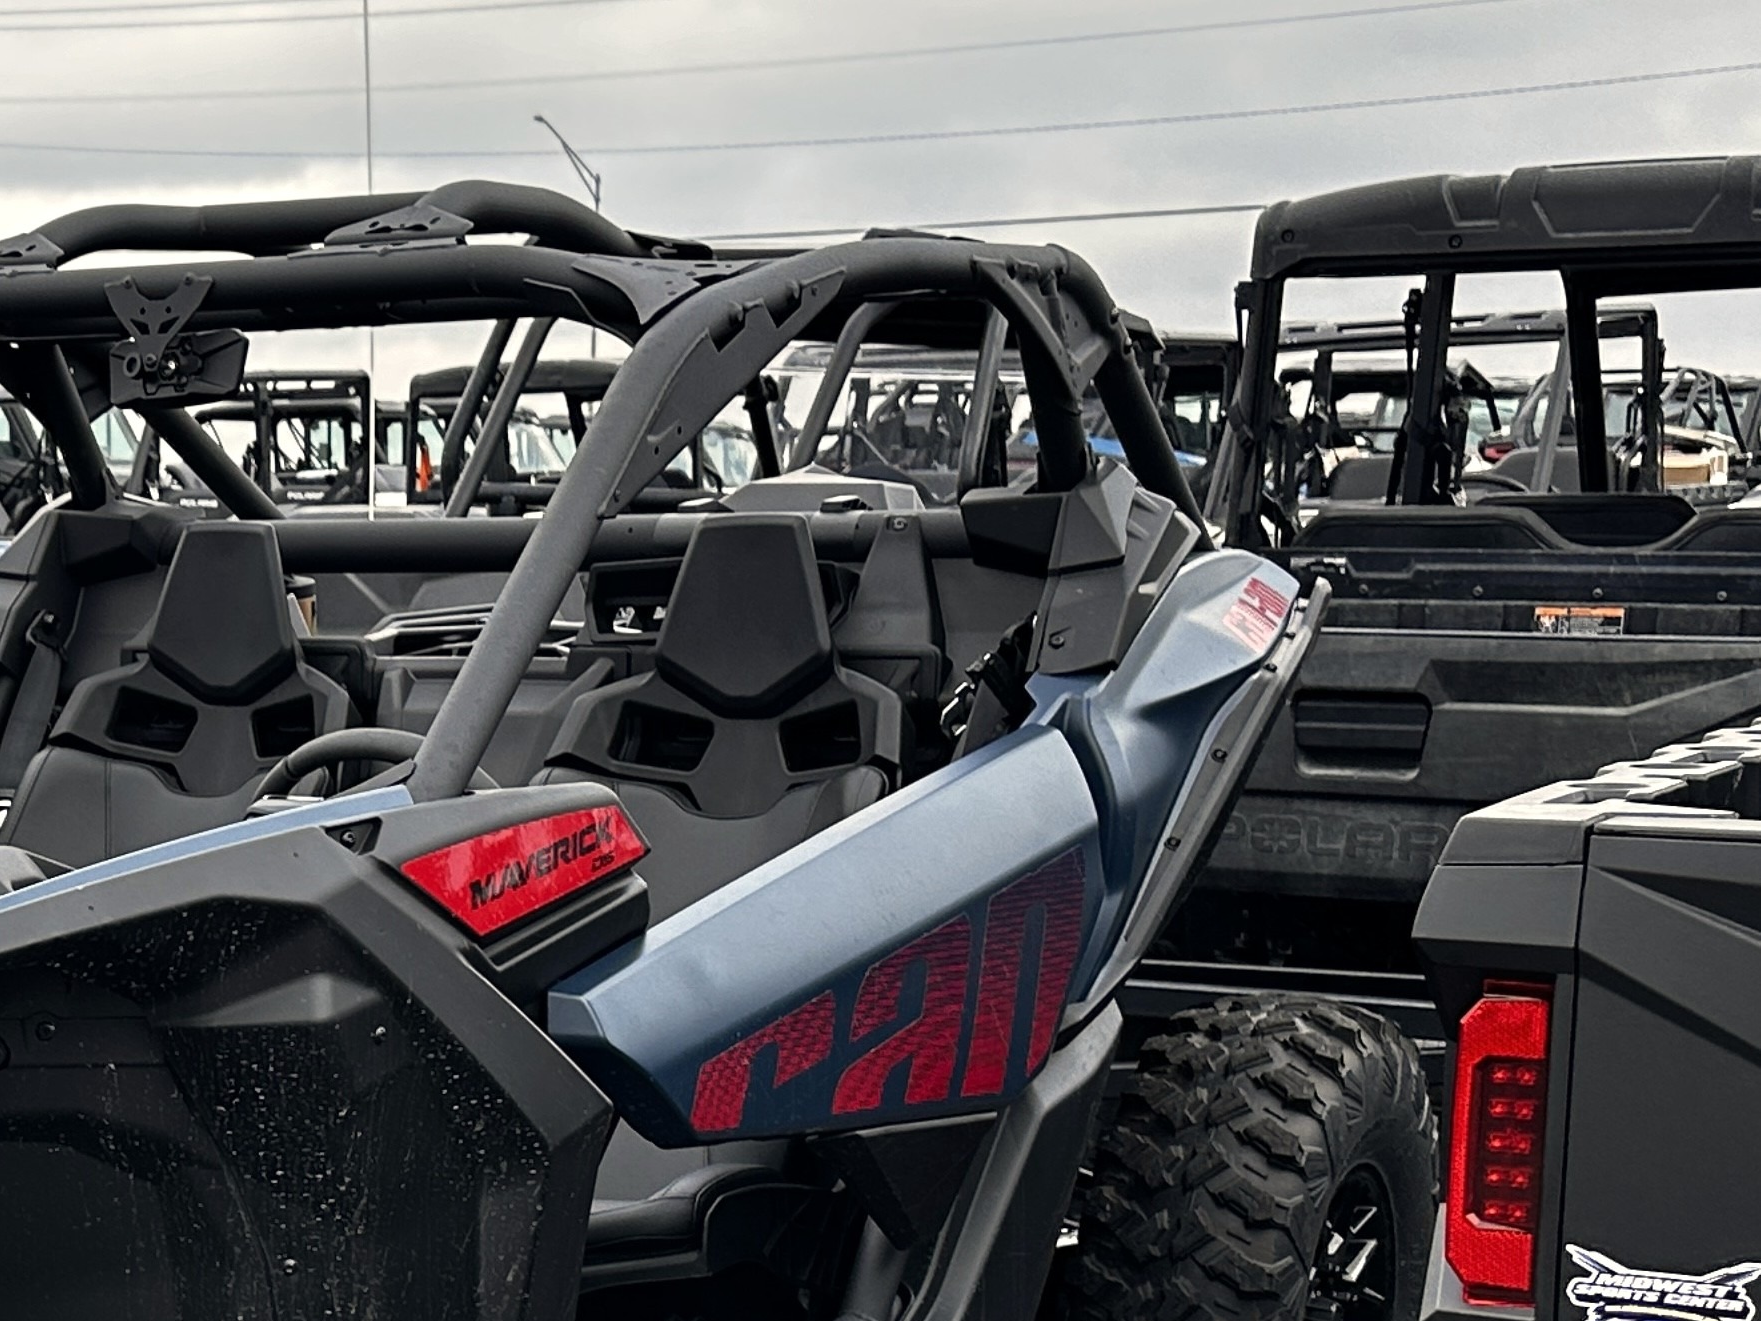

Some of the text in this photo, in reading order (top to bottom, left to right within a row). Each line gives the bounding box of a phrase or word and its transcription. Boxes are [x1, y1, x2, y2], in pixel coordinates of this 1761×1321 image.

[468, 815, 613, 911] MAVERICK
[1573, 1283, 1746, 1312] SPORTS CENTER
[1595, 1273, 1733, 1298] MIDWEST
